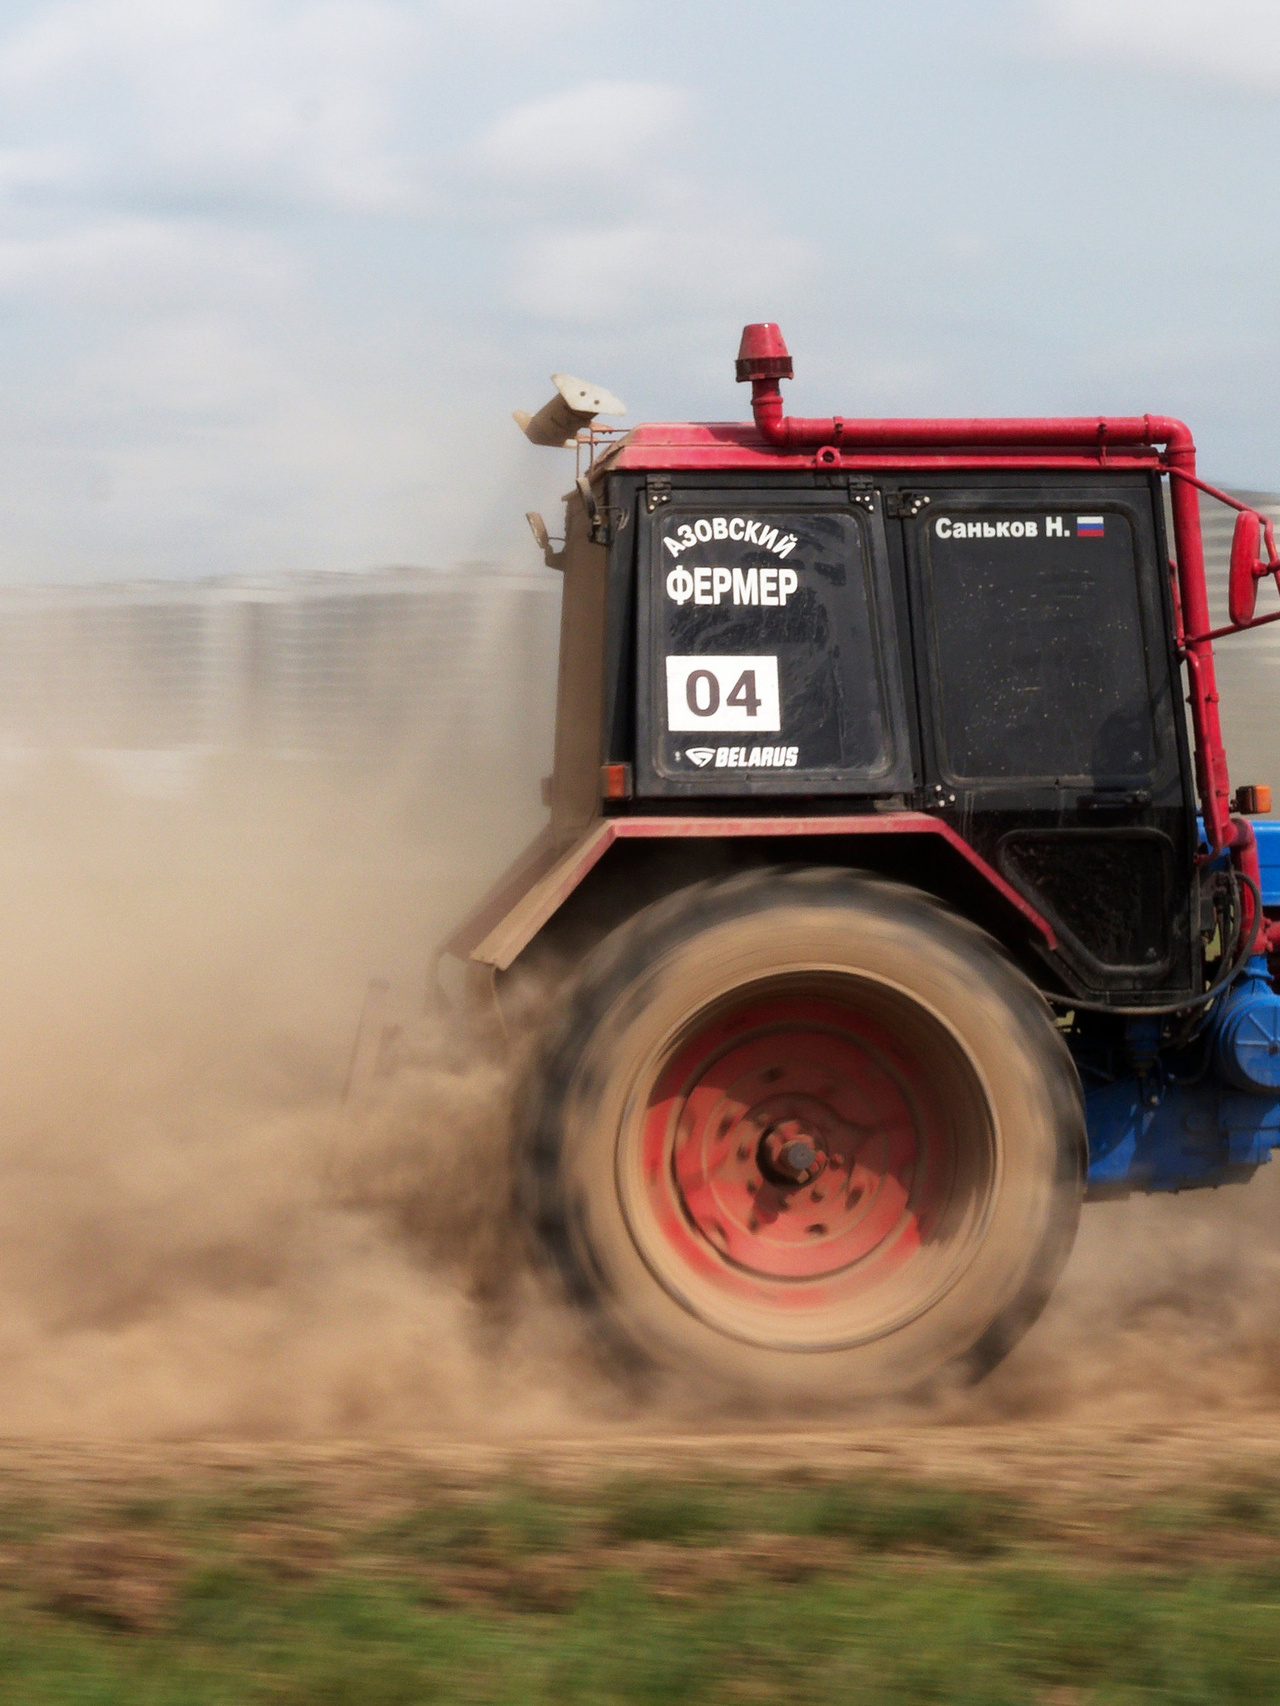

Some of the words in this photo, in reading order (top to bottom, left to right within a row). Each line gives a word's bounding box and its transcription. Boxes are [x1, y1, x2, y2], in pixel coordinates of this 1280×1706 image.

[663, 517, 798, 559] АЗОВСКИЙ
[935, 517, 1038, 539] Саньков
[1045, 516, 1071, 538] Н.
[666, 565, 798, 606] ФЕРМЕР
[686, 669, 762, 717] 04
[715, 746, 799, 768] BELARUS
